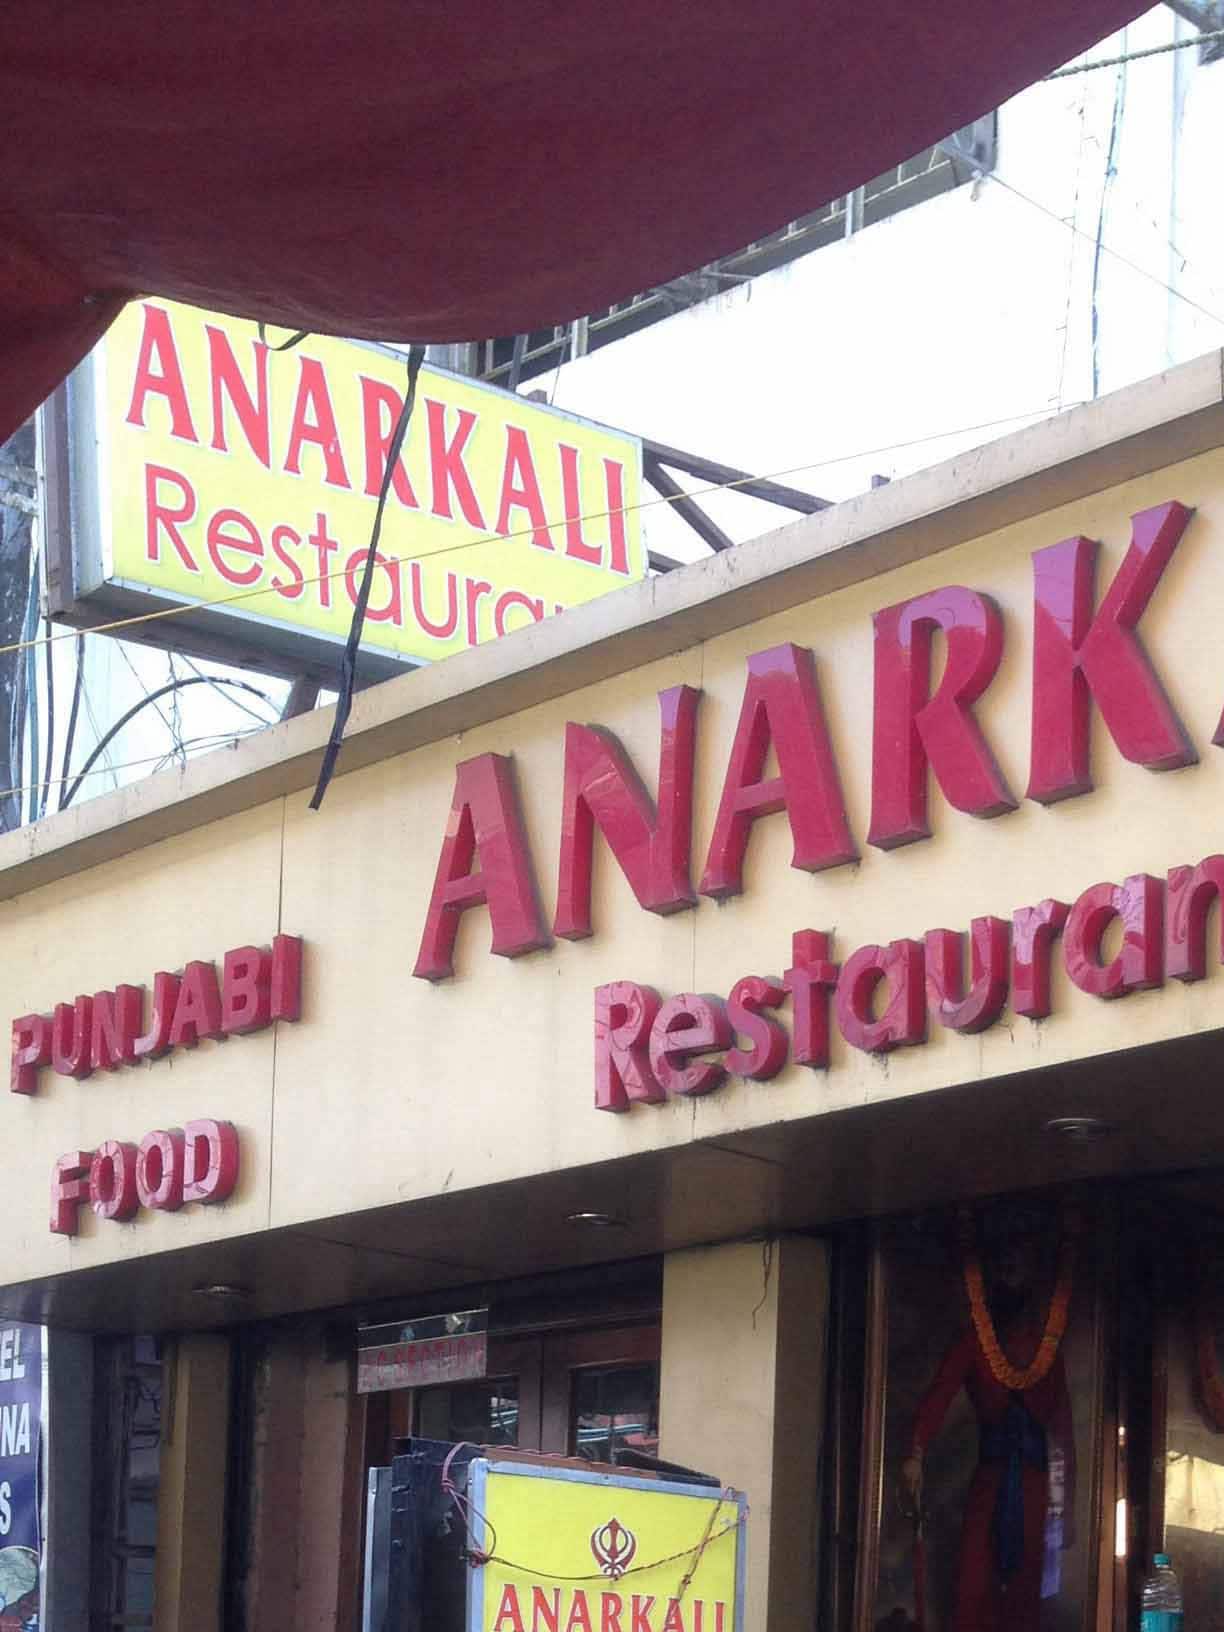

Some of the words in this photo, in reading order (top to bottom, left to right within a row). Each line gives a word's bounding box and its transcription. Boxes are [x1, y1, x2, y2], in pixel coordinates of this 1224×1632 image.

[125, 303, 630, 576] ANARKALI
[145, 463, 563, 646] Restaura
[10, 933, 304, 1096] PUNJABI
[50, 1117, 240, 1237] FOOD
